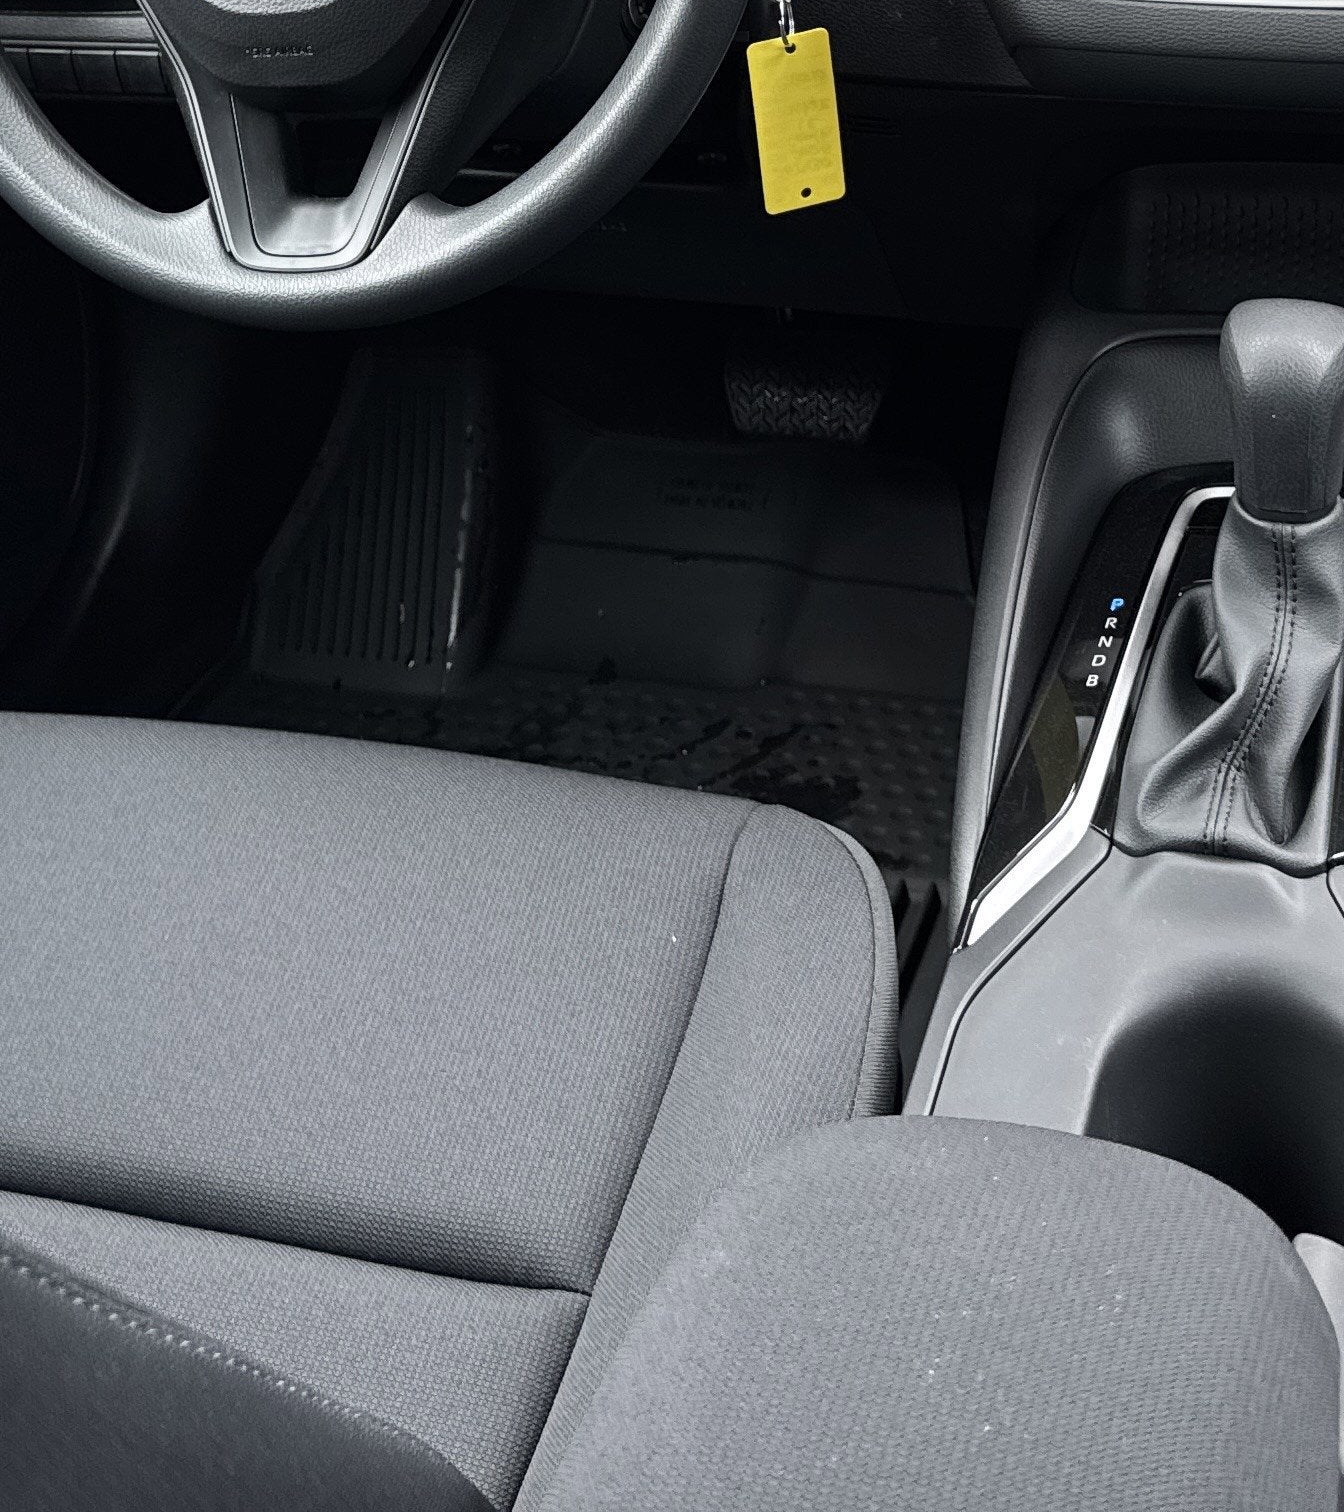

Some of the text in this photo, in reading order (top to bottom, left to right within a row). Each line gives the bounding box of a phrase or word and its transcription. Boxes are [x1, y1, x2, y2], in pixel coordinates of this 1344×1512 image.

[1110, 598, 1124, 611] P
[1104, 617, 1117, 629] R
[1098, 636, 1113, 648] N
[1091, 655, 1106, 667] D
[1085, 675, 1099, 687] B
